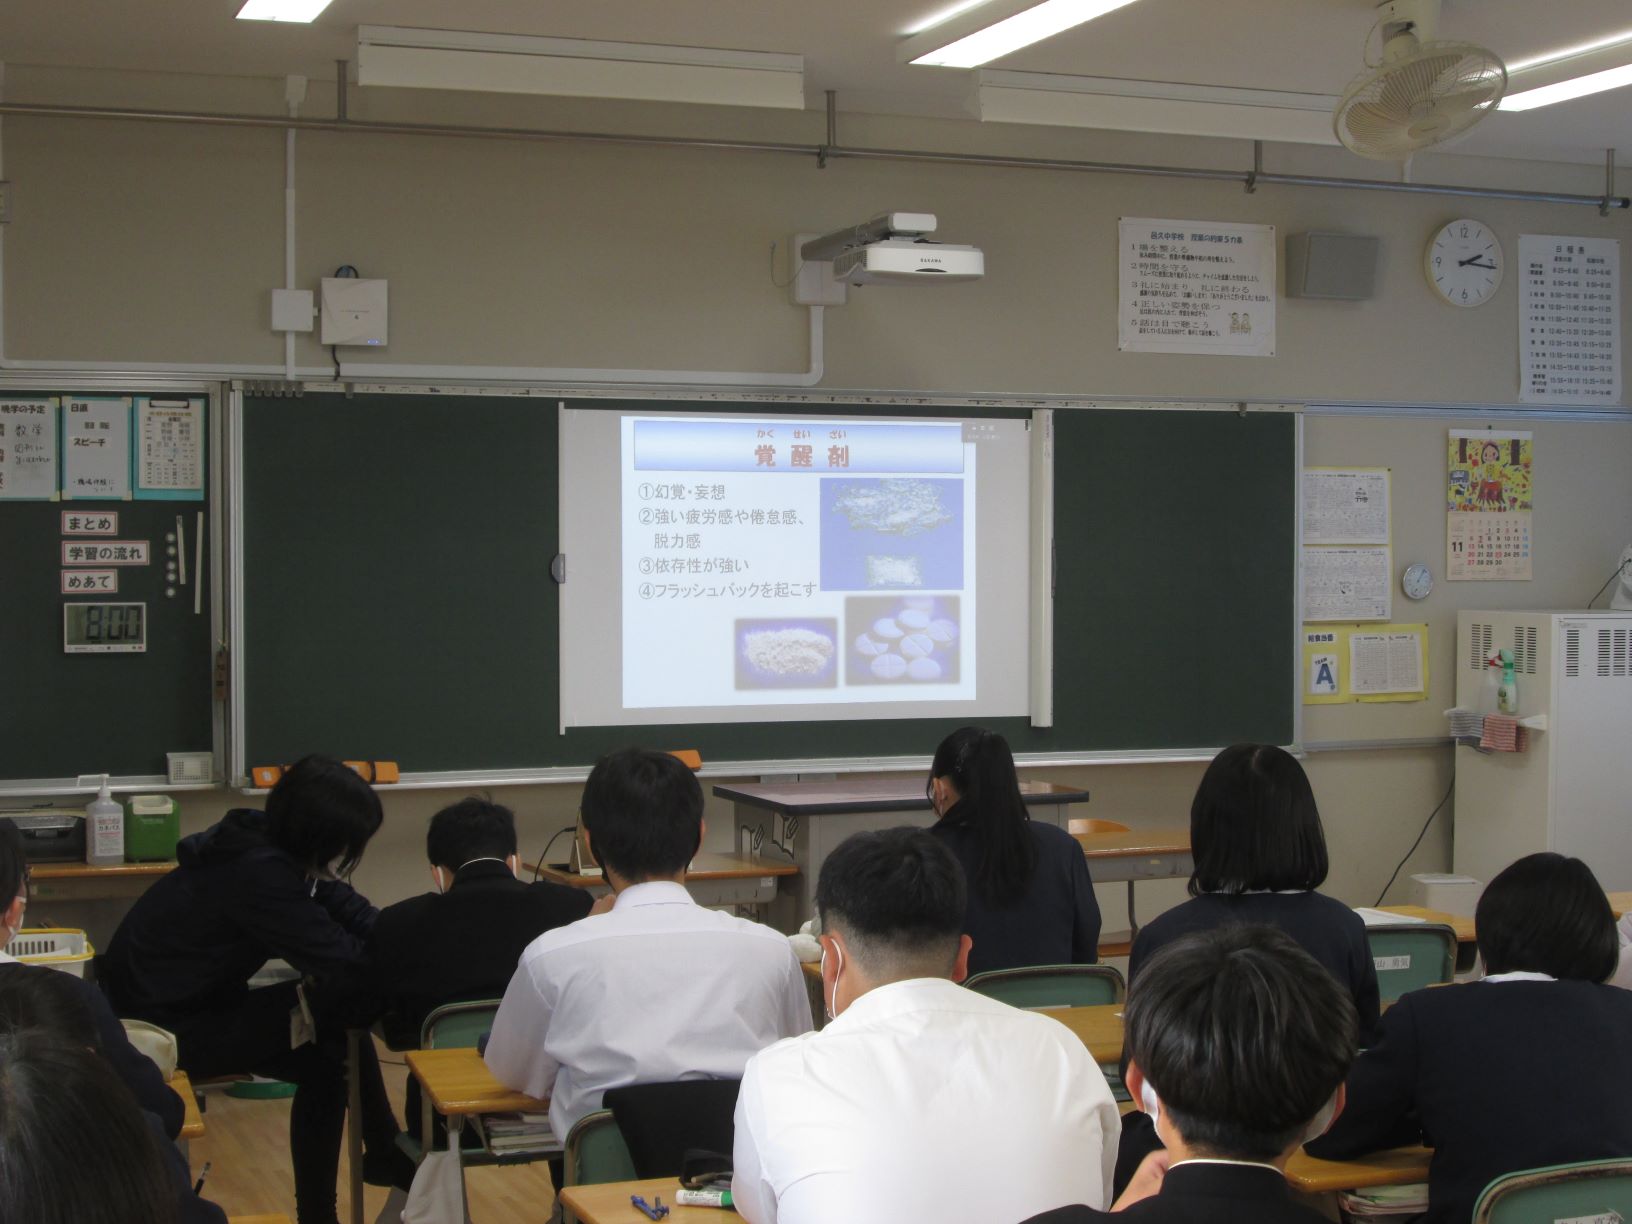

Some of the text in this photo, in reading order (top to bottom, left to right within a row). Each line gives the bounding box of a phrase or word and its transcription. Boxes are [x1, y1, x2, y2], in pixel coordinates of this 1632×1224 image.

[1460, 227, 1469, 239] 12
[1435, 257, 1442, 267] 9
[1461, 289, 1468, 299] 6
[70, 403, 89, 413] 日直
[756, 429, 847, 441] かく せい ざい
[73, 437, 107, 448] スピーチ
[754, 444, 850, 468] 覚醒剤
[68, 516, 113, 531] まとめ
[653, 532, 702, 550] 脱力感
[1451, 541, 1464, 553] 11
[69, 545, 144, 561] 学習の流れ
[638, 557, 750, 575] ③依存性が強い
[68, 574, 112, 590] めあて
[1316, 663, 1334, 684] A
